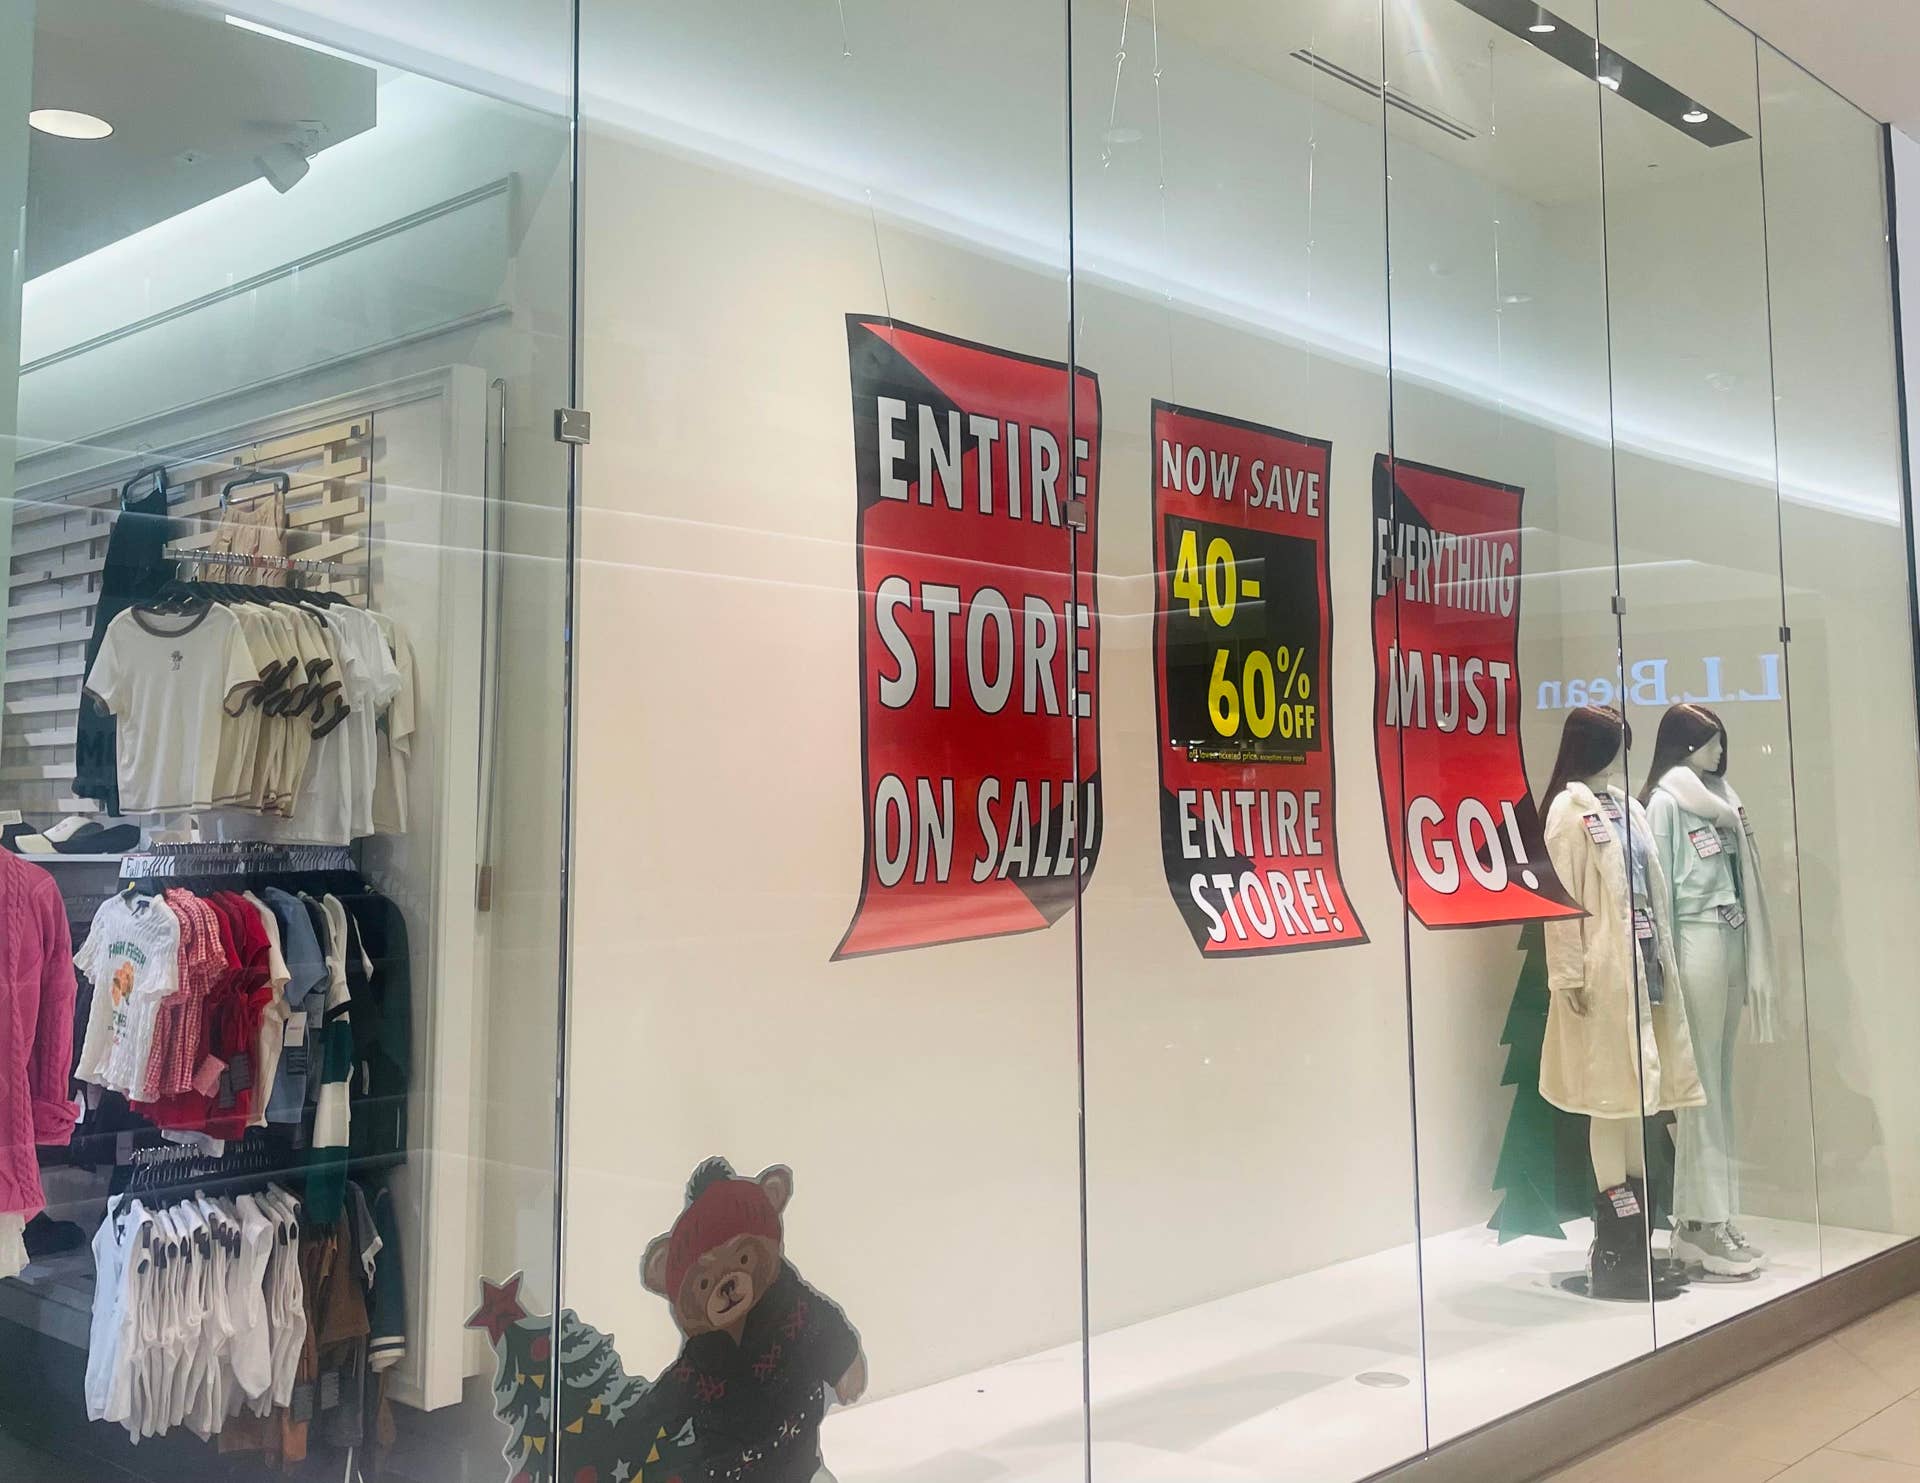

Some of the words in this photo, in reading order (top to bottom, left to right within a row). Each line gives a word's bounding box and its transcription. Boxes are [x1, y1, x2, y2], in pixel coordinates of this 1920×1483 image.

[877, 396, 1089, 532] ENTIRE
[1161, 440, 1240, 502] NOW
[1249, 460, 1320, 518] SAVE
[1172, 529, 1260, 627] 40-
[1377, 517, 1515, 618] EVERYTHING
[876, 577, 1091, 718] STORE
[1385, 647, 1511, 735] MUST
[1279, 704, 1315, 740] OFF
[874, 773, 954, 888] ON
[972, 778, 1096, 883] SALE!
[1178, 790, 1322, 860] ENTIRE
[1406, 796, 1540, 895] GO!
[1190, 869, 1344, 944] STORE!
